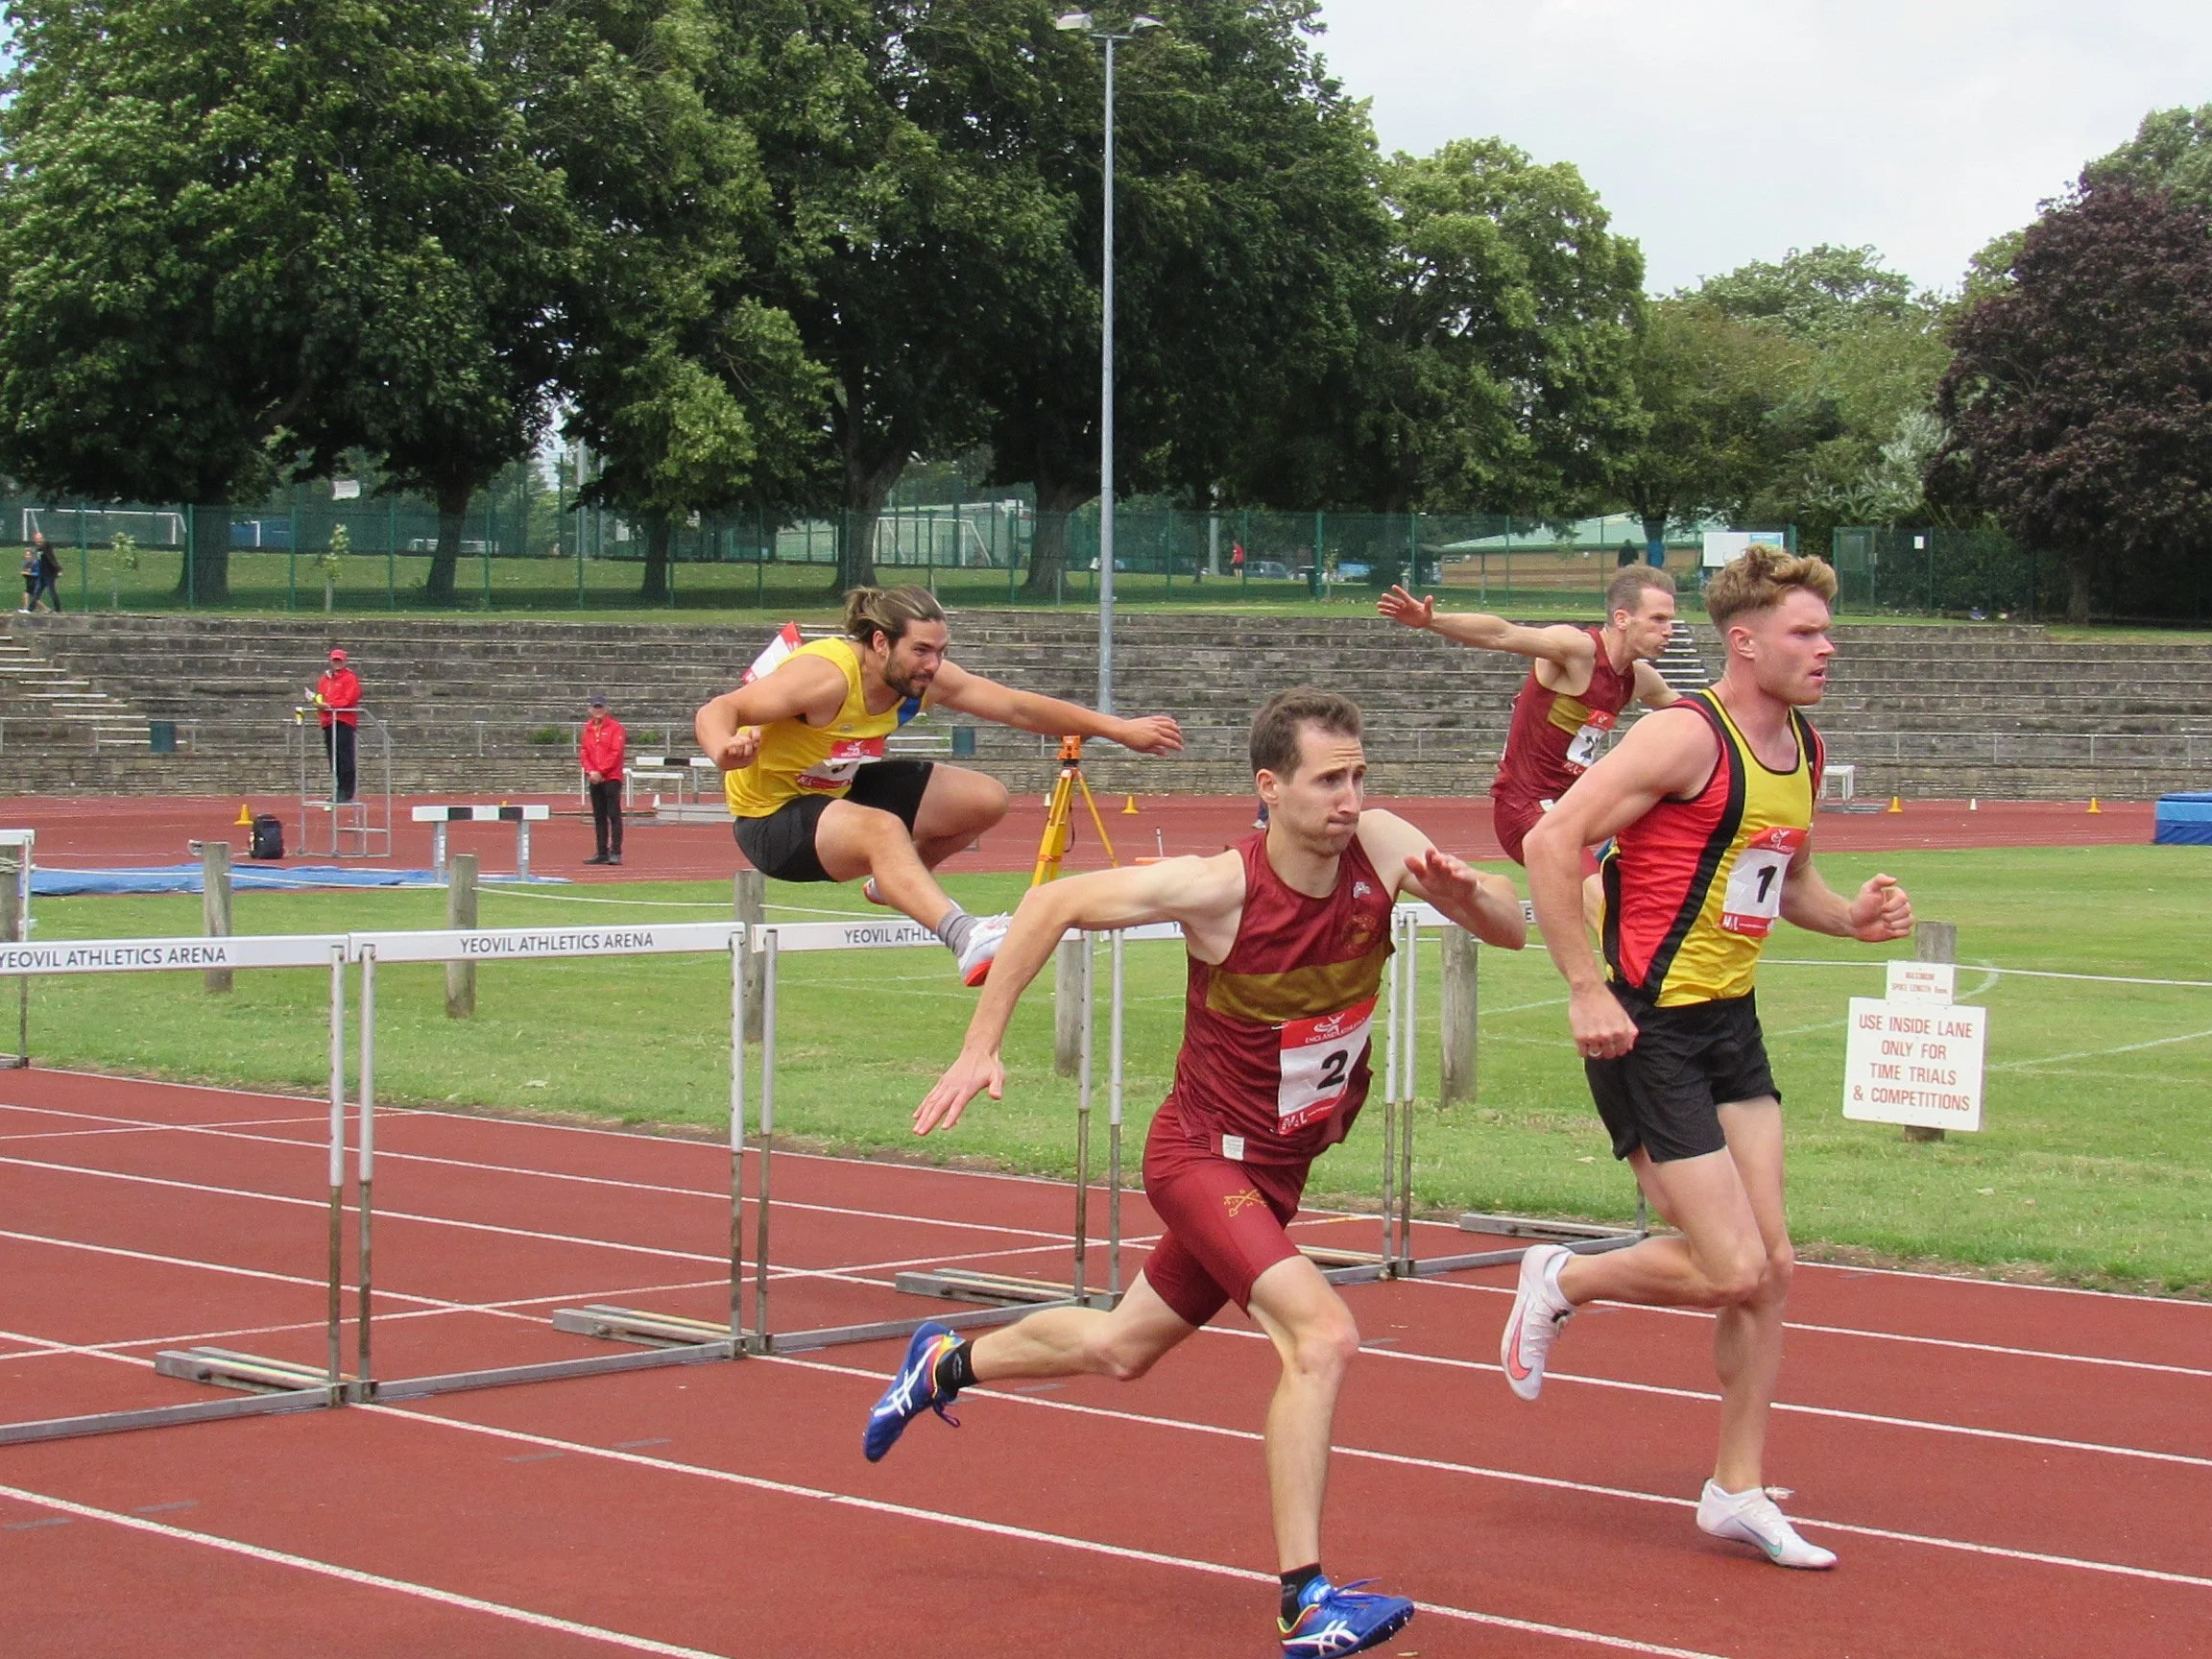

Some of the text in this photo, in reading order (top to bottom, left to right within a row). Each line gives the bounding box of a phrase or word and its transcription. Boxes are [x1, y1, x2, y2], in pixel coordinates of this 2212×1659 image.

[1757, 865, 1778, 903] 1
[461, 932, 654, 953] YEOVIL ATHLETICS ARENA
[844, 927, 937, 944] YEOVIL ATHLE
[0, 946, 228, 969] YEOVIL ATHLETICS ARENA
[1859, 1014, 1973, 1038] USE INSIDE LANE
[1881, 1040, 1947, 1060] ONLY FOR
[1316, 1049, 1349, 1091] 2
[1870, 1062, 1957, 1086] TIME TRIALS
[1853, 1085, 1970, 1111] & COMPETITIONS
